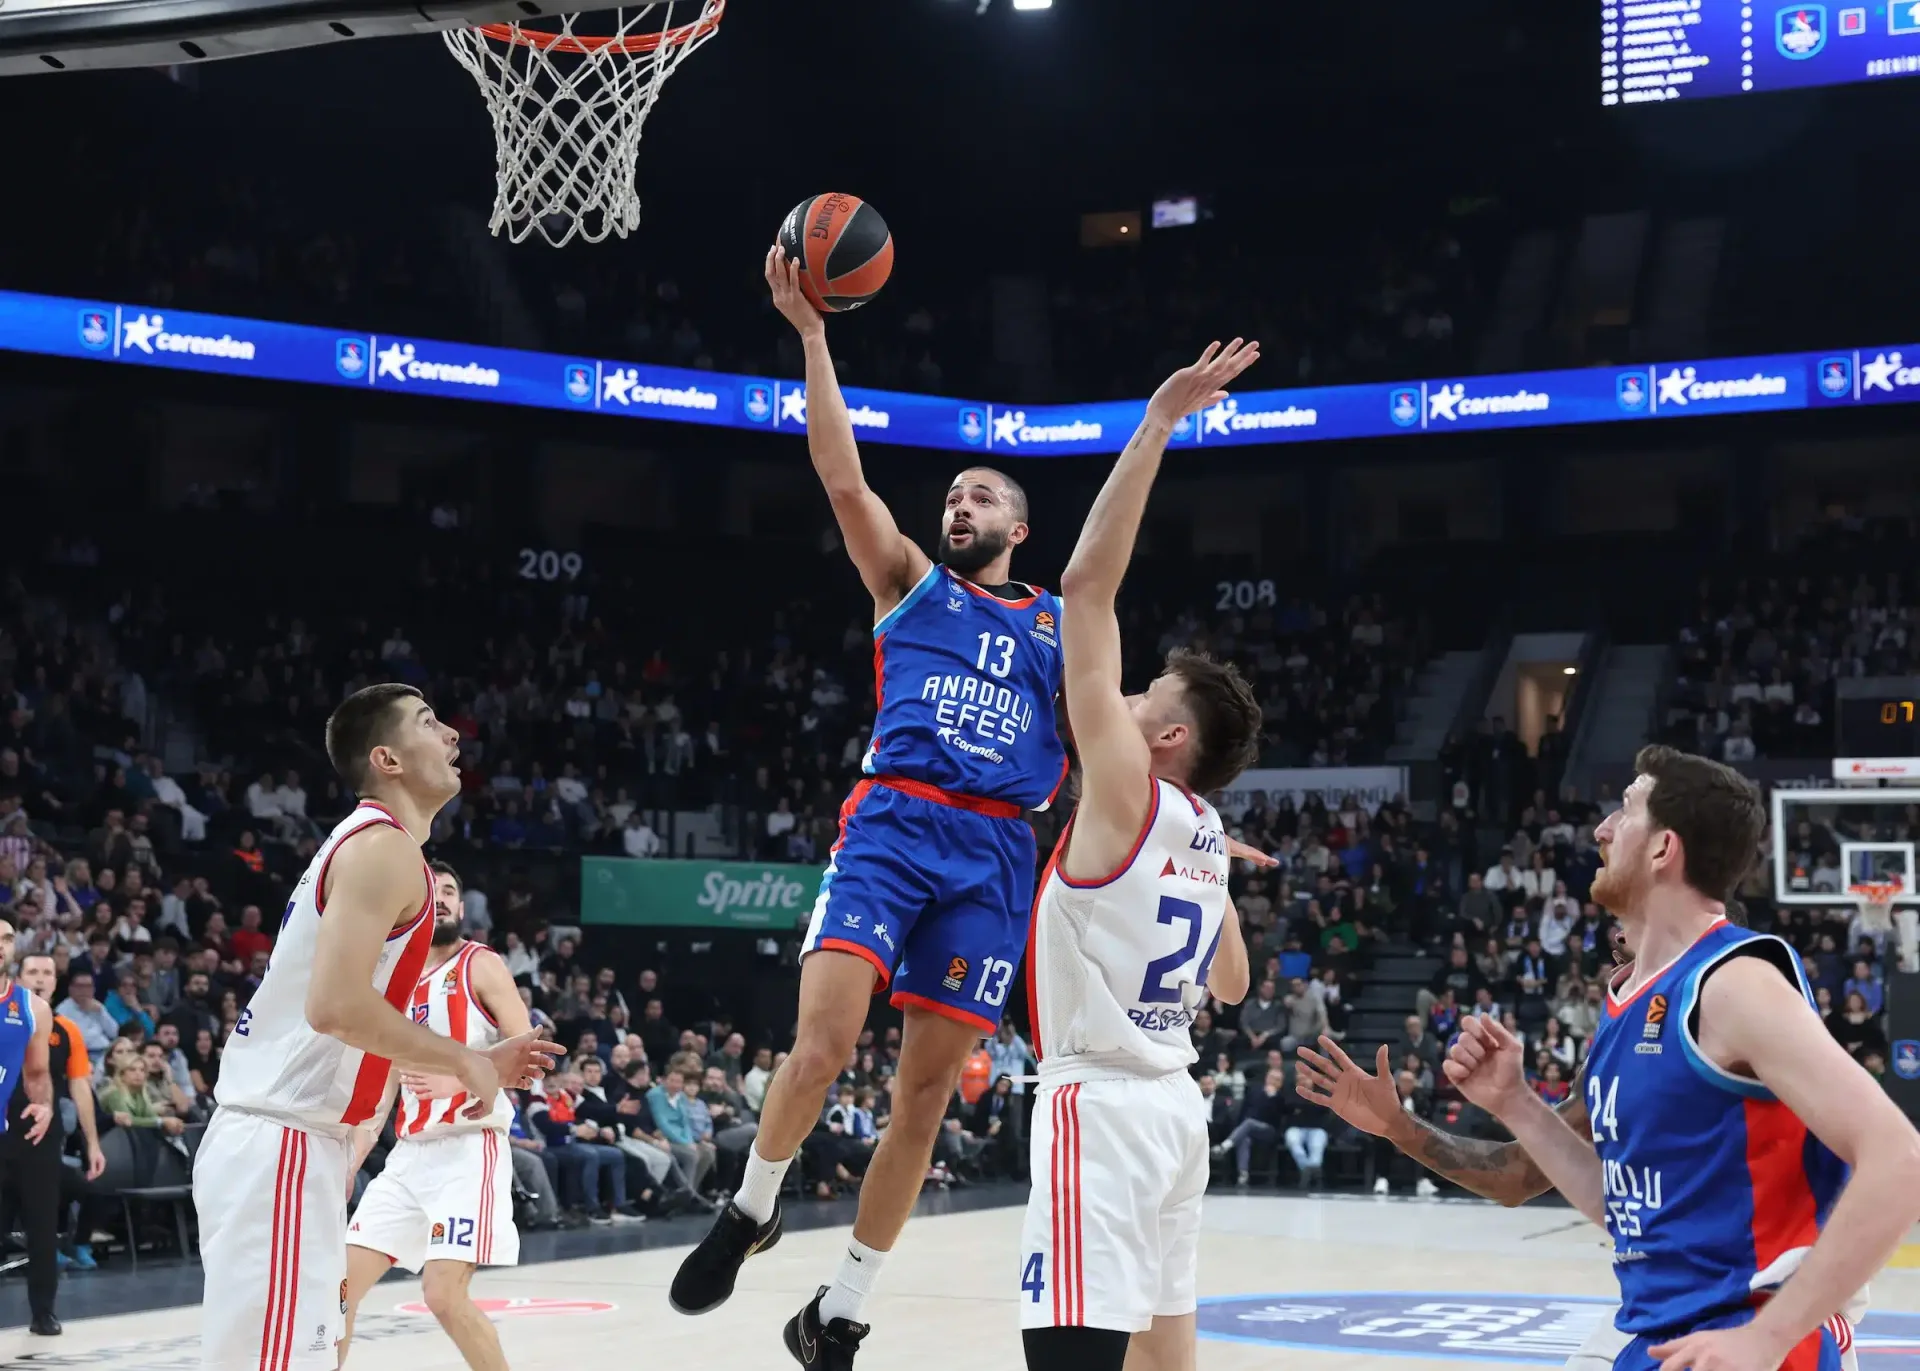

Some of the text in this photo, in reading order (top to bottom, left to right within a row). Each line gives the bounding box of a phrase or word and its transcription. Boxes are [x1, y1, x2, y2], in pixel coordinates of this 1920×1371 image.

[519, 548, 582, 581] 209
[1215, 579, 1276, 610] 208
[976, 631, 1016, 678] 13
[921, 675, 1033, 734] ANADOLU
[935, 699, 1018, 746] EFES
[952, 736, 1004, 765] corendon
[697, 871, 804, 915] Sprite
[973, 956, 1014, 1007] 13
[1588, 1075, 1620, 1143] 24
[447, 1217, 474, 1247] 12
[1019, 1252, 1045, 1303] 4
